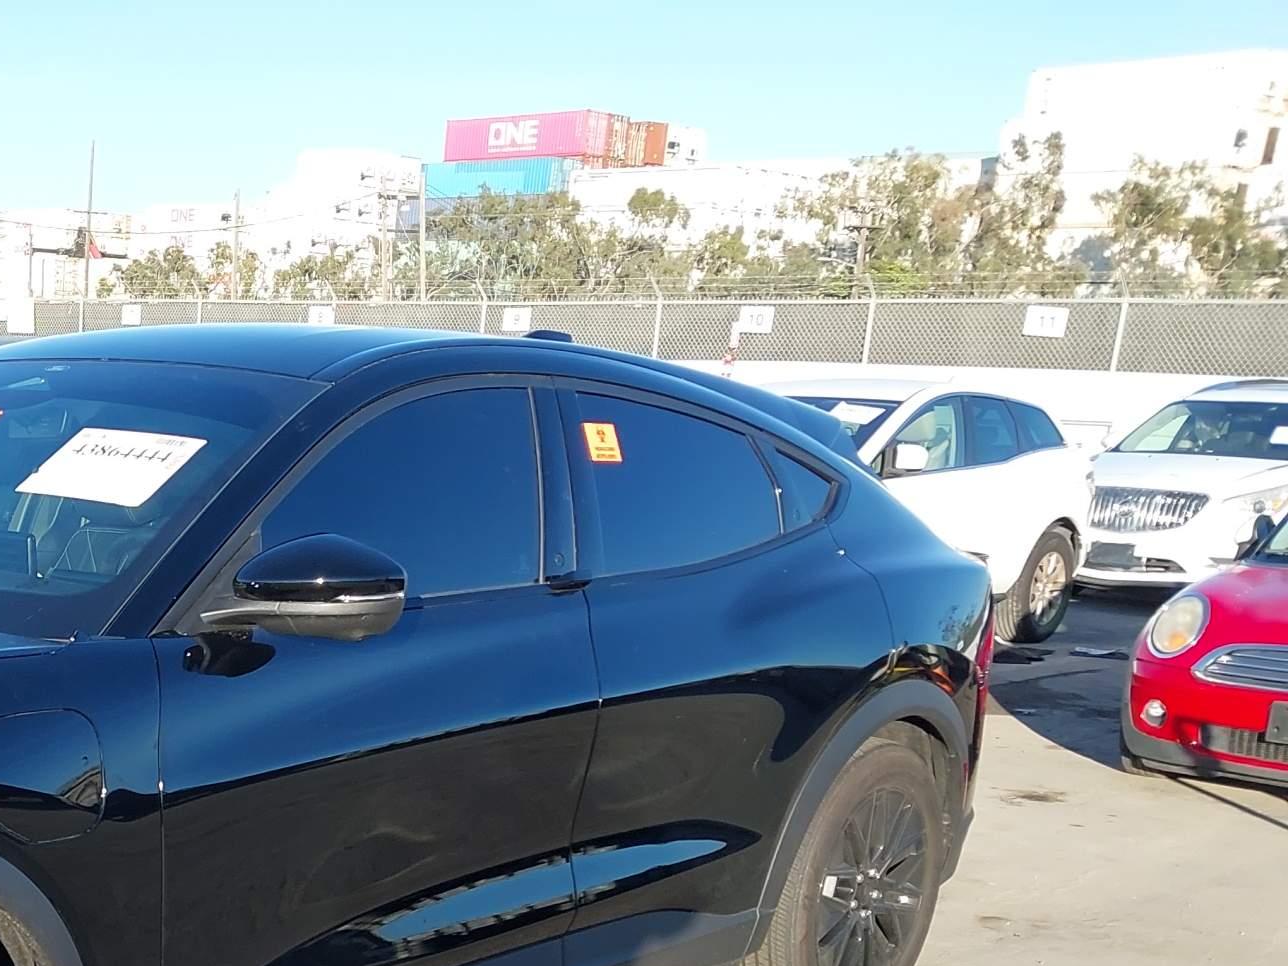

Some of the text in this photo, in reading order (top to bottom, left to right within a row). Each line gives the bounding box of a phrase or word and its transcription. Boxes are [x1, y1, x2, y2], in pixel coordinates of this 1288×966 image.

[488, 119, 540, 146] ONE
[171, 208, 195, 223] ONE
[749, 313, 764, 326] 10
[72, 443, 173, 463] 43864444
